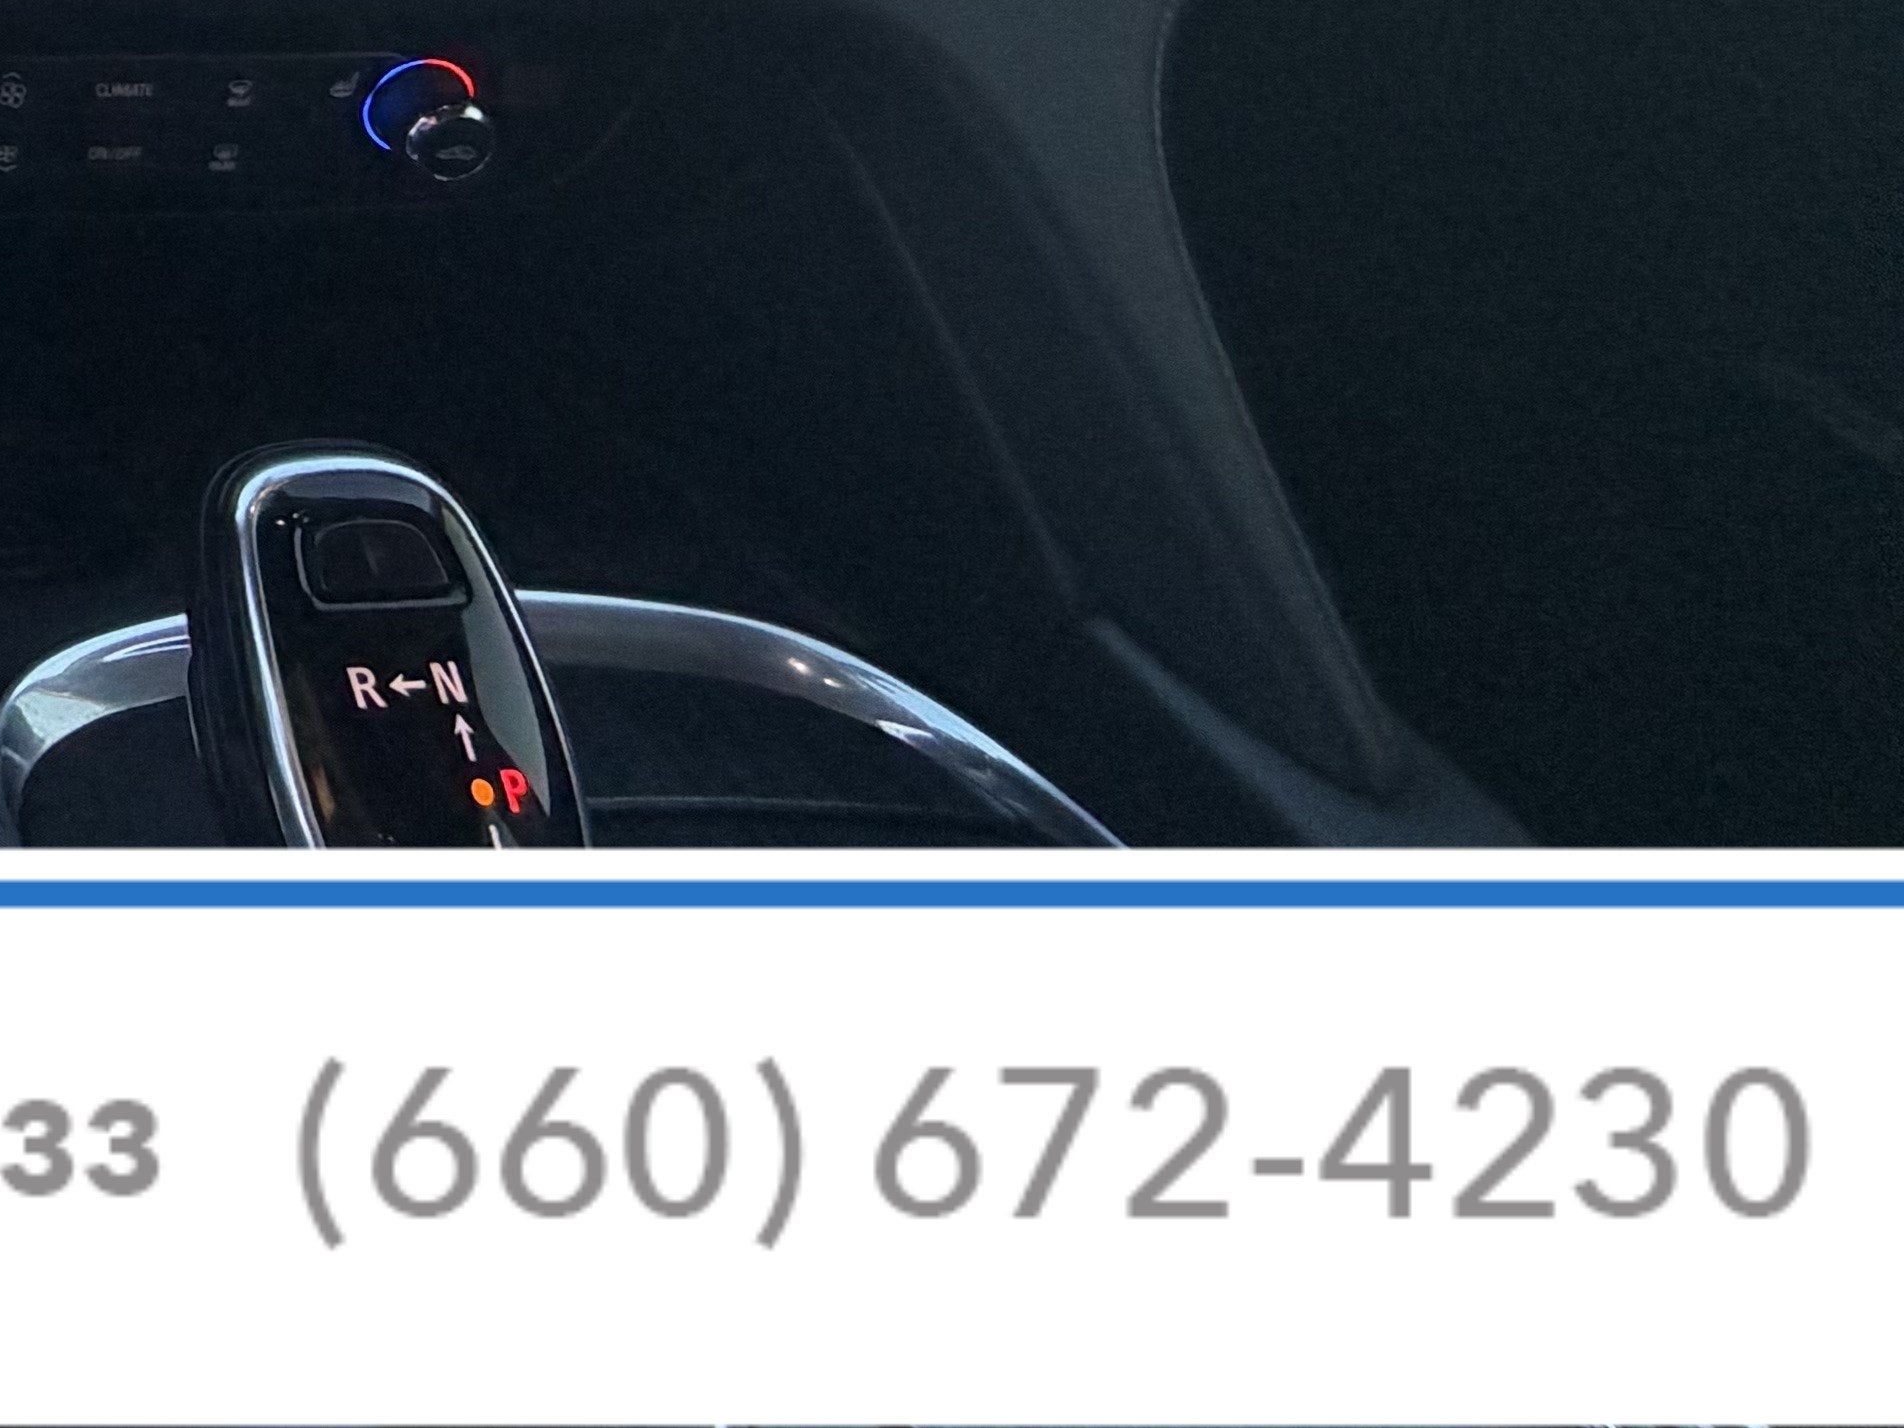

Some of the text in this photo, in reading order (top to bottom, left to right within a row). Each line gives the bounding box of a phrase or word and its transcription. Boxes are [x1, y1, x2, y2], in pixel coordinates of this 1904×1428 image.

[346, 660, 468, 710] R N
[499, 768, 529, 814] P
